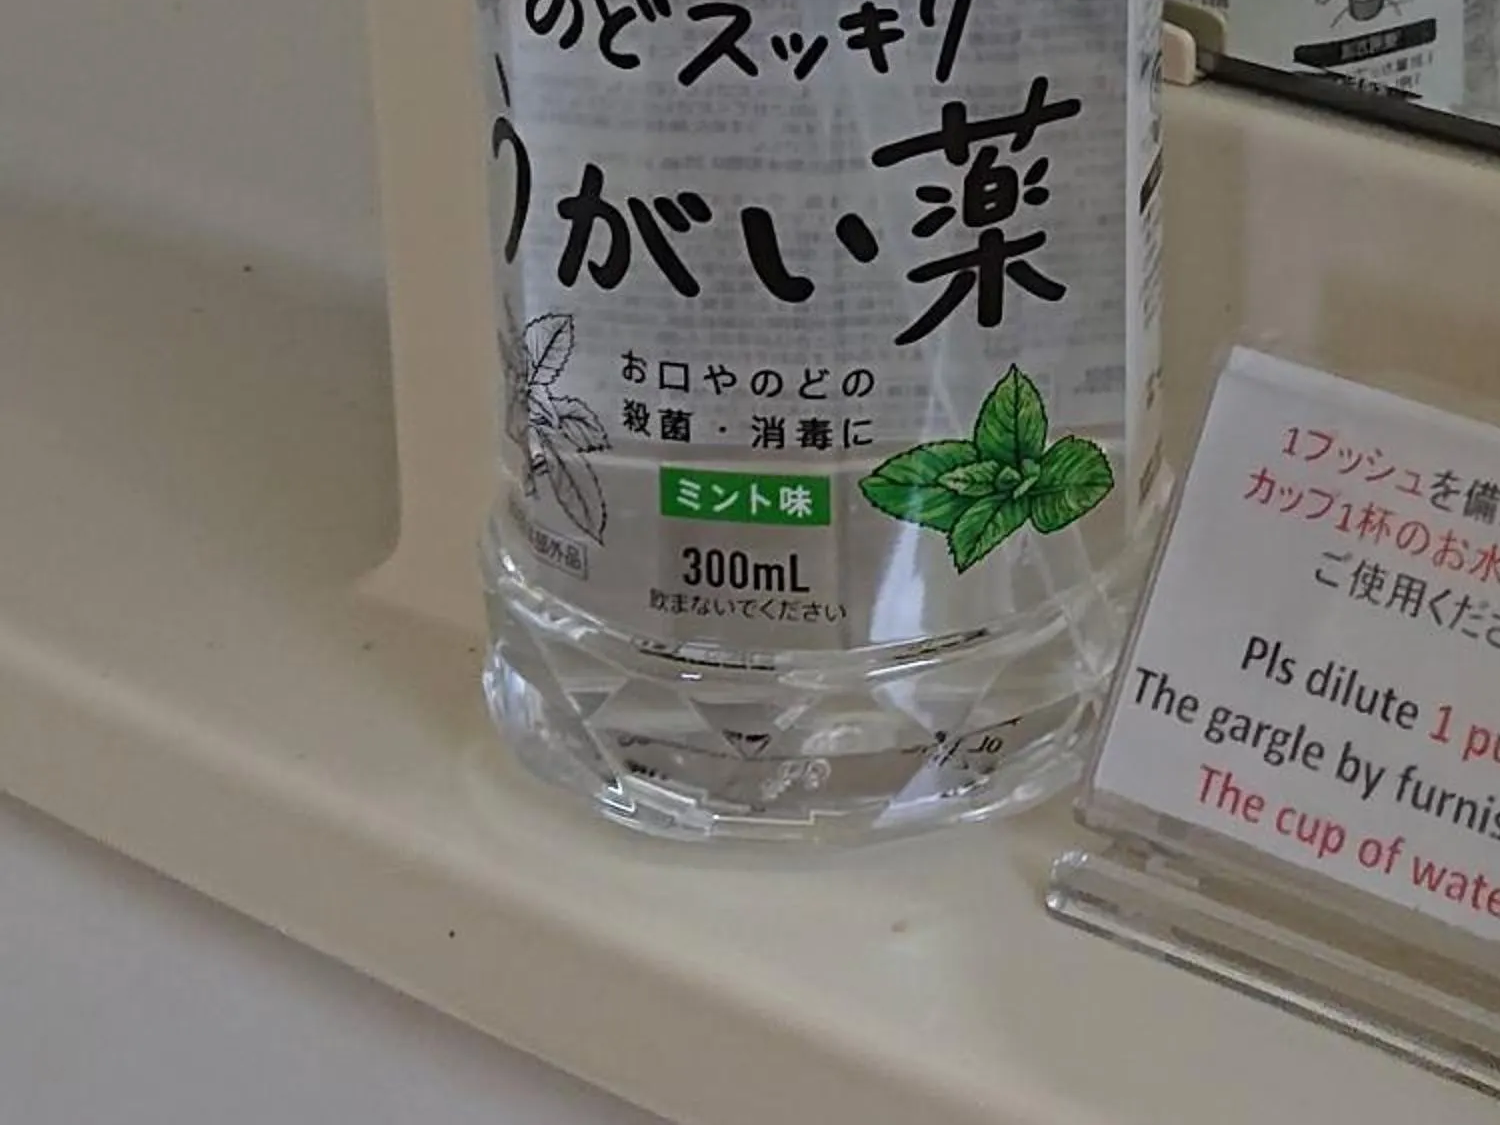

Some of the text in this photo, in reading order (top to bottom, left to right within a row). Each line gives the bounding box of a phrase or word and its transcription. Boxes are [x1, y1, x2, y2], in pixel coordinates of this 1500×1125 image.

[621, 351, 875, 399] お口やのどの
[622, 398, 874, 449] 殺菌・消毒に
[677, 480, 812, 518] ミント味
[528, 528, 581, 570] 部外品
[682, 547, 810, 593] 300mL
[649, 588, 847, 623] 飲まないでください
[1242, 636, 1294, 685] Pls
[1307, 663, 1420, 729] dilute
[1428, 705, 1451, 741] 1
[1134, 668, 1199, 724] The
[1204, 705, 1325, 770] gargle
[1336, 742, 1385, 800] by
[1197, 765, 1264, 823] The
[1276, 808, 1346, 856] cup
[1359, 833, 1407, 873] of
